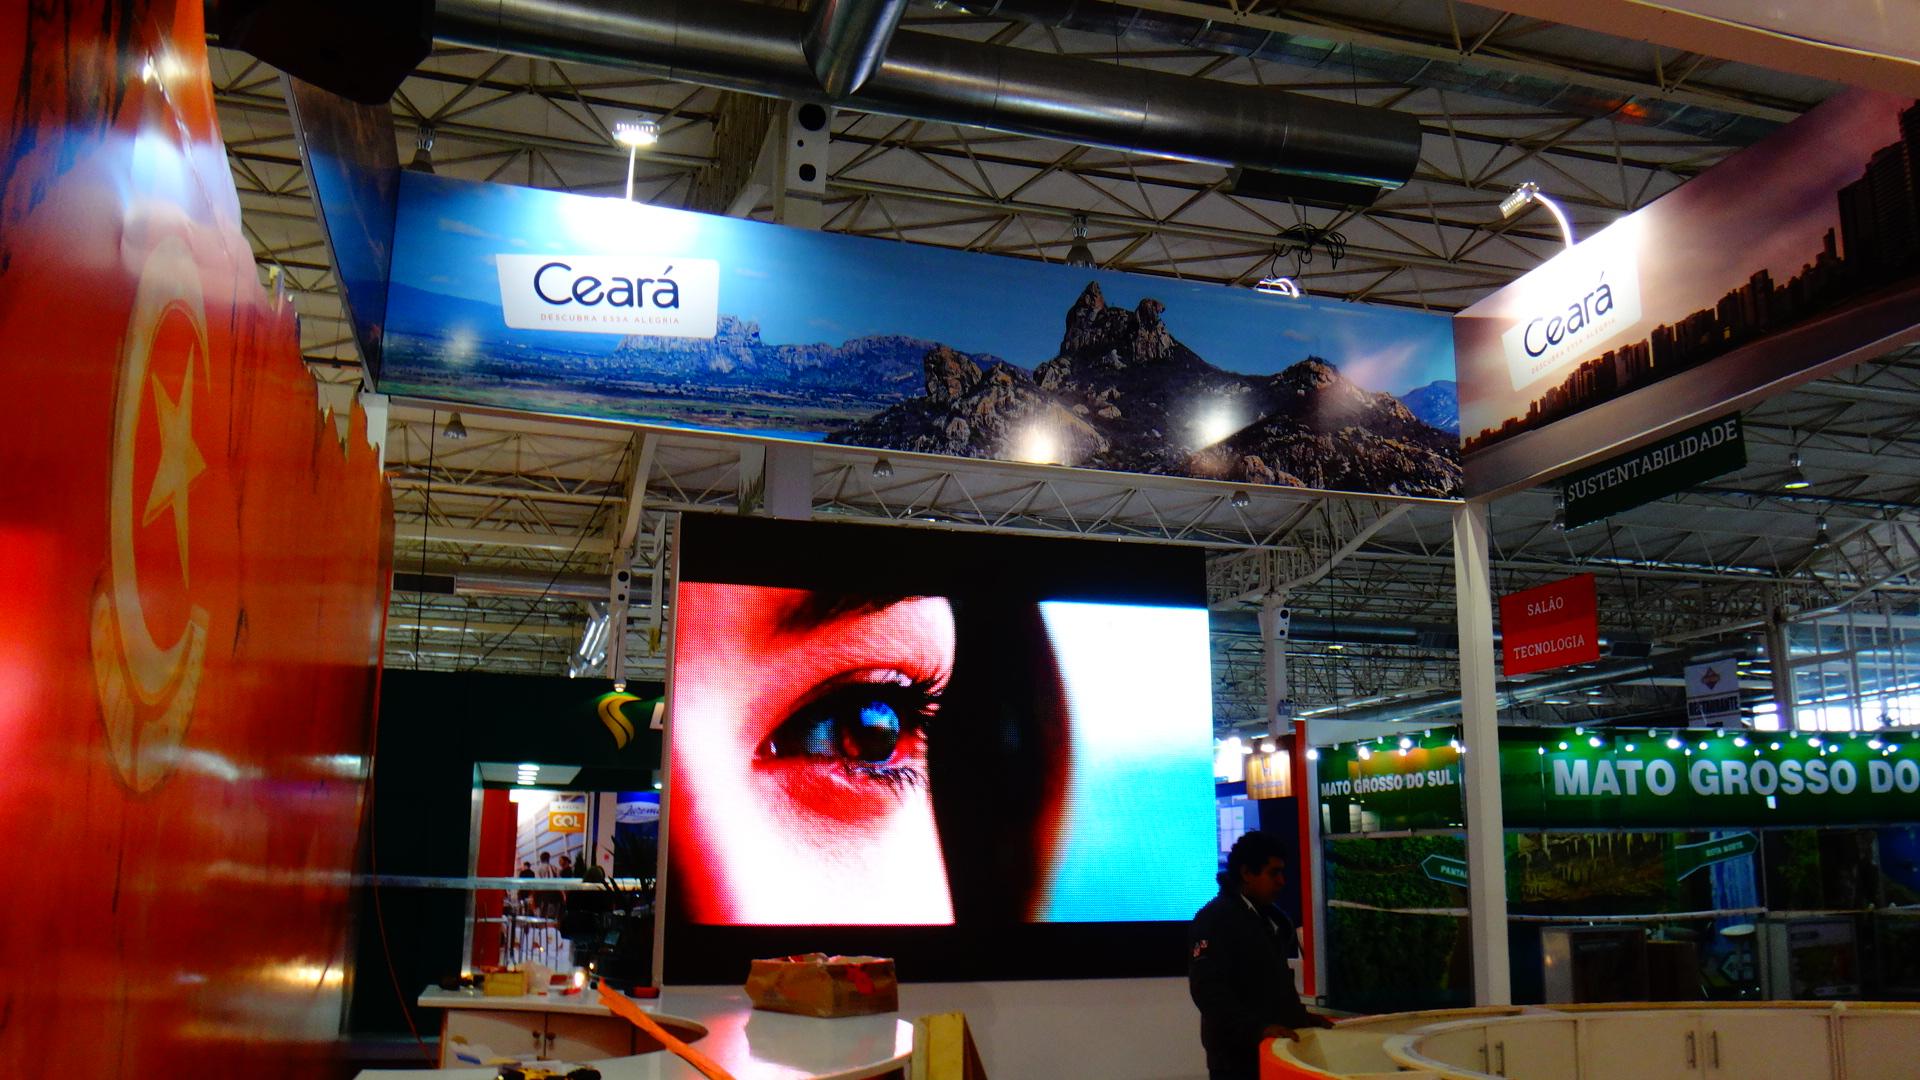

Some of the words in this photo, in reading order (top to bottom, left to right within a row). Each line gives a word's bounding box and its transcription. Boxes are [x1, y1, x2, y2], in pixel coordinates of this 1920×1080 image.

[534, 262, 680, 309] Ceará
[540, 313, 598, 322] DESCUBRA
[602, 315, 629, 323] ESSA
[633, 316, 680, 325] ALEGRIA
[1524, 271, 1613, 357] Ceará
[1567, 419, 1738, 502] SUSTENTABILIDADE
[1527, 596, 1564, 616] SALÃO
[1513, 634, 1585, 660] TECNOLOGIA
[1321, 780, 1350, 797] MATO
[1354, 776, 1402, 794] GROSSO
[1407, 772, 1424, 789] DO
[1427, 769, 1454, 786] SUL
[1552, 759, 1676, 796] MATO
[1690, 759, 1857, 796] GROSSO
[1868, 759, 1920, 795] DO
[552, 814, 581, 828] GOL
